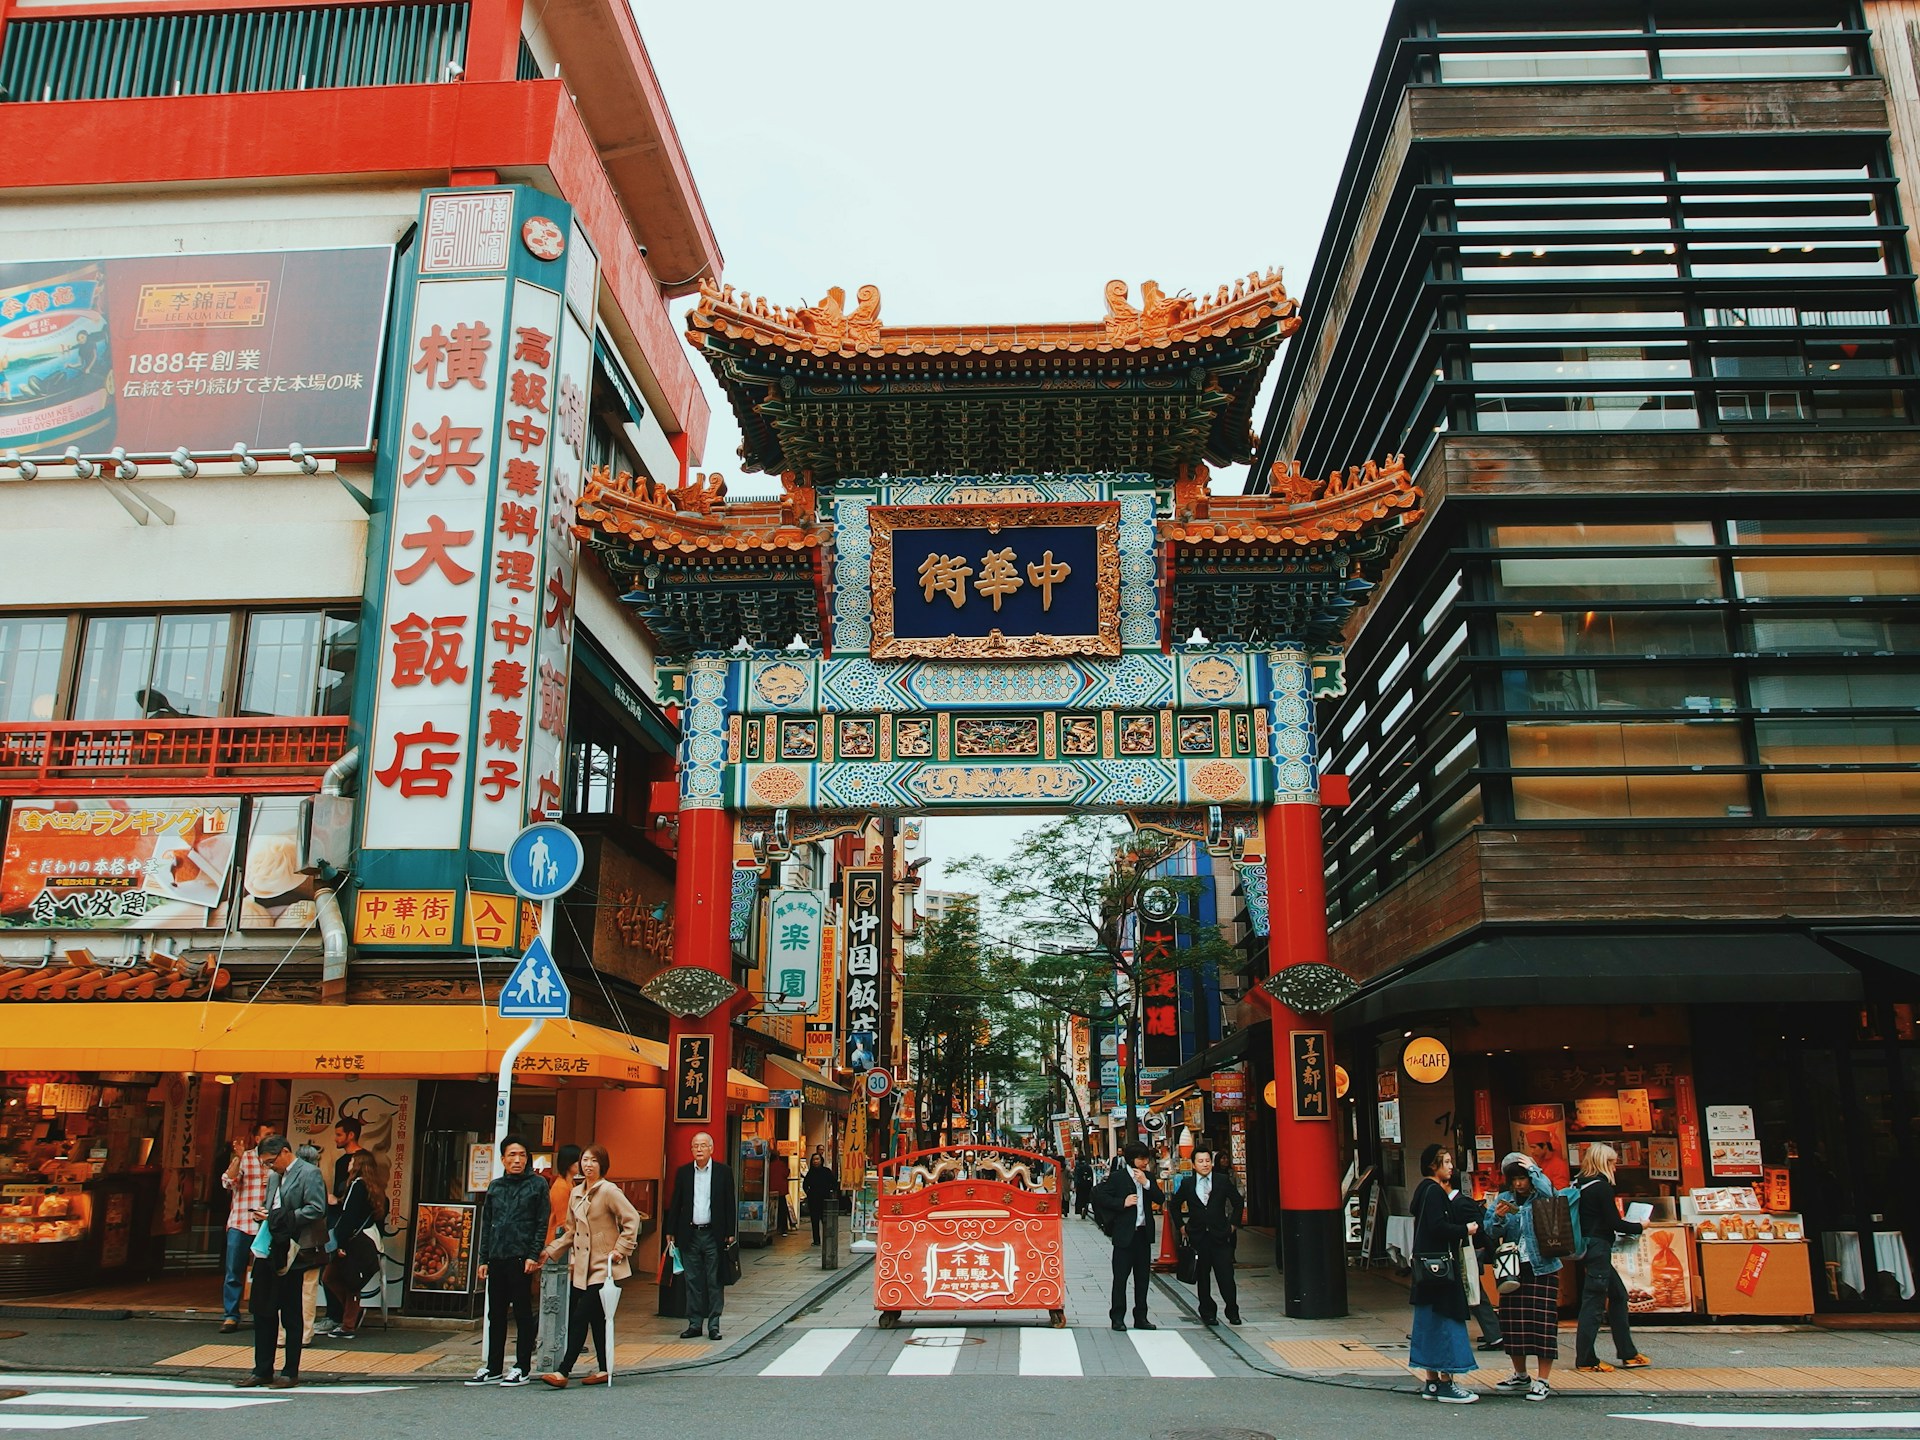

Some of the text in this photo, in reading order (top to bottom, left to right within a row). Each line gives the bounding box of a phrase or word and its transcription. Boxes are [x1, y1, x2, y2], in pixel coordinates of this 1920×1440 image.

[170, 291, 237, 311] 李錦記
[165, 311, 234, 321] LEE KUM KEE
[128, 349, 261, 374] 1888年創業
[122, 373, 363, 398] 伝統を守り続けてきた本場の味
[0, 406, 96, 437] REMIUM OYSTER SAUCE
[17, 405, 74, 426] LEE KUM KEE
[374, 320, 493, 800] 横浜大飯店
[479, 326, 553, 803] 高級中華料理・中華菓子
[208, 818, 225, 832] 1位
[27, 857, 159, 876] こだわりの本格中華
[30, 889, 147, 919] 食べ放題
[365, 897, 450, 921] 中華街
[363, 923, 447, 938] 大通り入口
[473, 900, 507, 942] 入口
[779, 923, 811, 998] 楽園
[821, 928, 834, 1021] 中国料理世界チャンピオン
[807, 1033, 833, 1044] 100円
[315, 1054, 365, 1070] 大粒甘栗
[1422, 1053, 1447, 1067] CAFE
[870, 1076, 886, 1091] 30
[295, 1096, 332, 1125] 元祖
[390, 1094, 409, 1226] 中華街名物 横浜大飯店の自信作
[950, 1254, 991, 1267] 不准
[937, 1268, 1005, 1281] 車馬駛入
